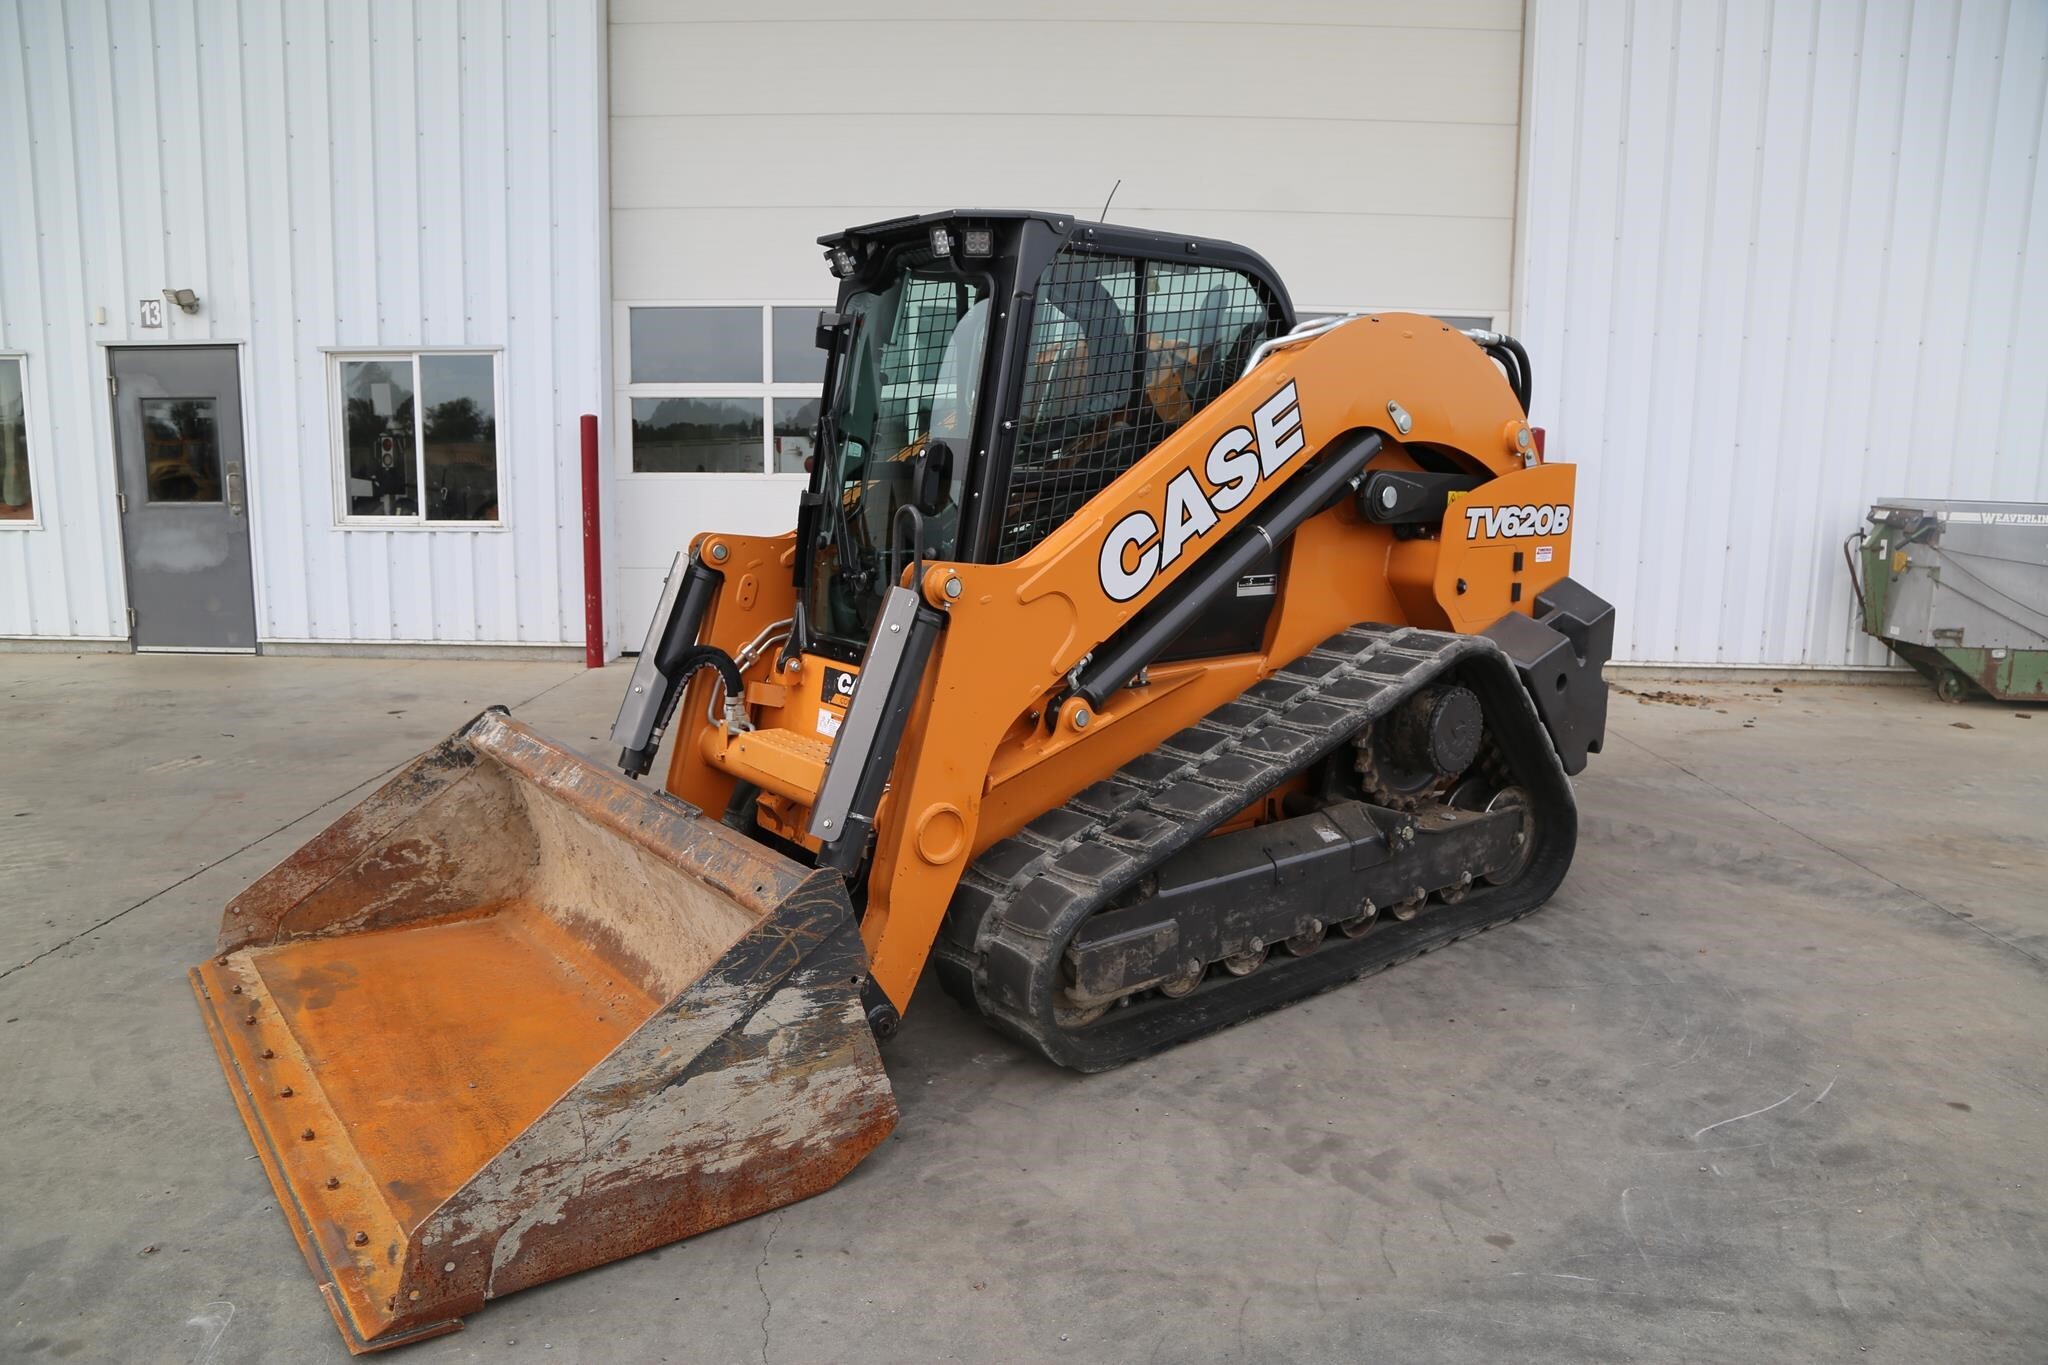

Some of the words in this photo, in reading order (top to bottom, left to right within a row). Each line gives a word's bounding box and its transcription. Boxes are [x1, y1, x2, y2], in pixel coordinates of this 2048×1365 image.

[141, 301, 161, 325] 13
[1098, 378, 1305, 603] CASE
[1465, 504, 1571, 539] TV620B
